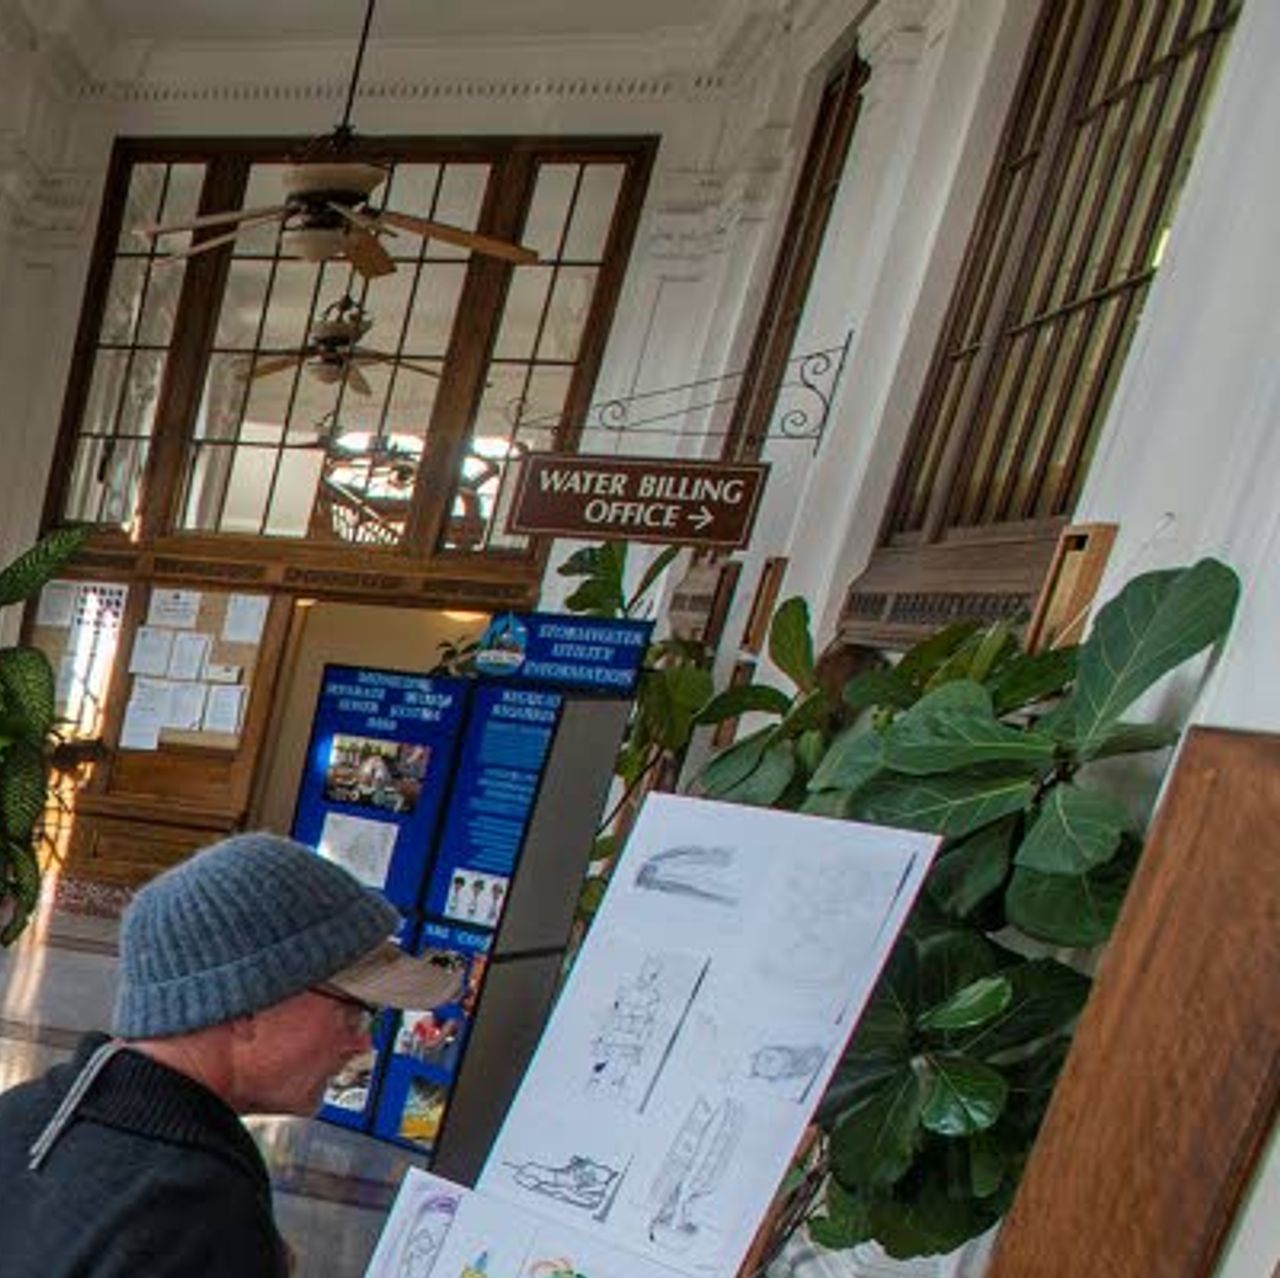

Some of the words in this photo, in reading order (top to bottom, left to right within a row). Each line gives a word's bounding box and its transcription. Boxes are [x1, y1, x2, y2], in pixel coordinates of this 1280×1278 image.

[540, 470, 628, 496] WATER
[637, 475, 744, 504] BILLING
[585, 499, 681, 527] OFFICE
[551, 642, 615, 662] UTILITY
[523, 659, 635, 686] INFORMATION
